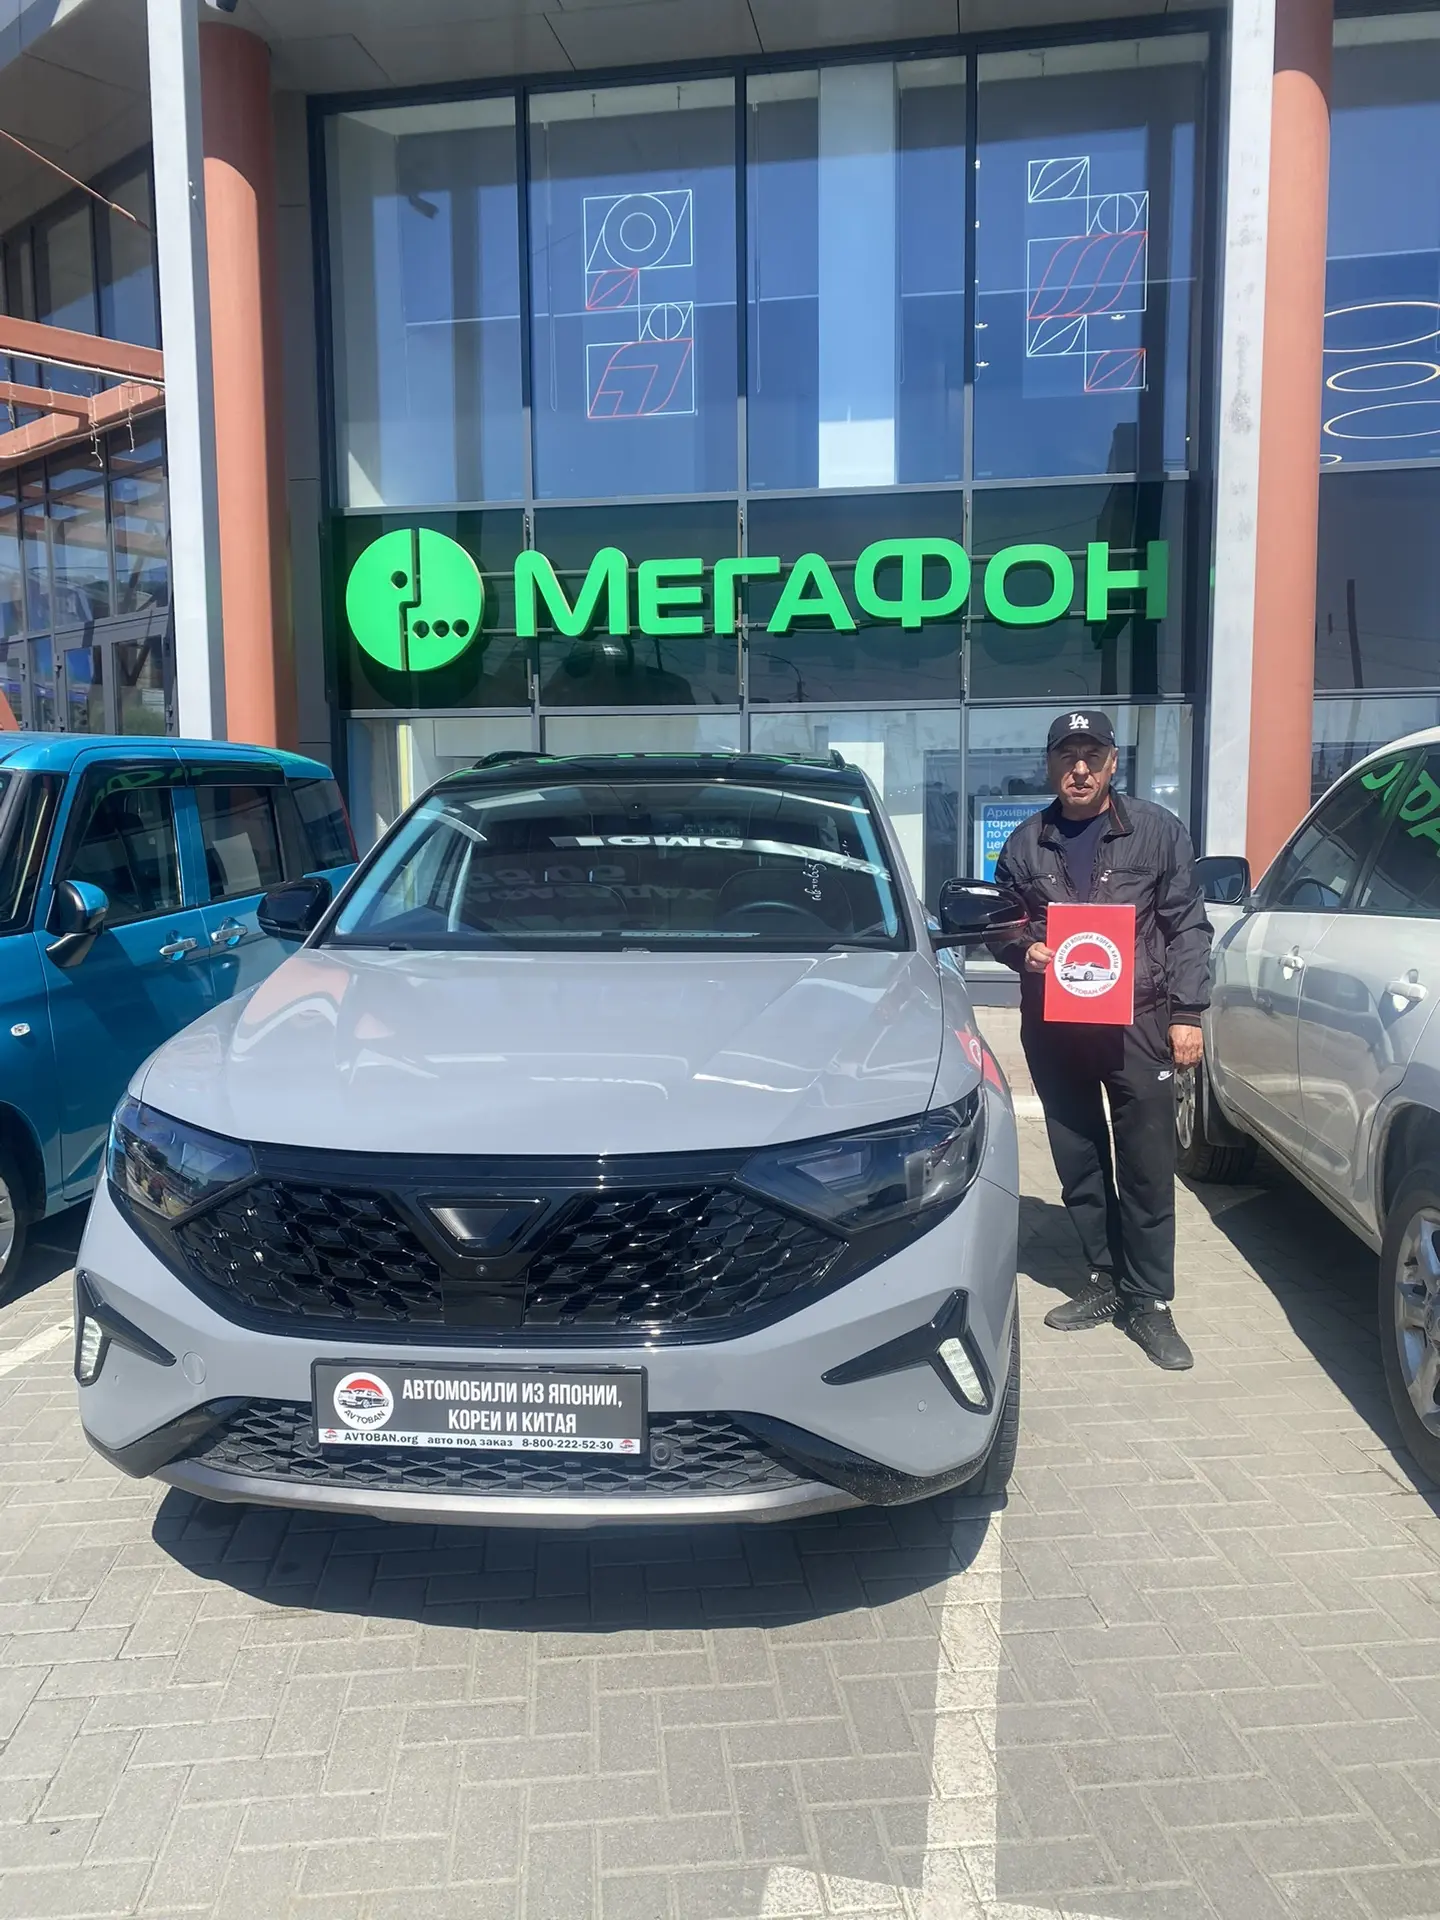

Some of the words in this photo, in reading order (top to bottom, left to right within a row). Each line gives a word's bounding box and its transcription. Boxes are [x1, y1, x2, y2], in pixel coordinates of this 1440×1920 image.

[514, 537, 1169, 637] МЕГАФОН
[1068, 713, 1090, 730] LA
[986, 808, 1040, 819] Архивны
[986, 819, 1024, 829] тариф
[986, 830, 1002, 838] по
[402, 1379, 517, 1403] АВТОМОБИЛИ
[522, 1383, 544, 1404] ИЗ
[548, 1384, 623, 1408] ЯПОНИИ,
[344, 1409, 386, 1424] AVTOBAN
[448, 1409, 501, 1431] КОРЕИ
[506, 1410, 517, 1432] И
[522, 1412, 577, 1434] КИТАЯ
[344, 1432, 419, 1445] AVTOBAN.org
[427, 1437, 453, 1445] авто
[479, 1438, 513, 1447] заказ
[522, 1438, 614, 1450] 8-800-222-52-30
